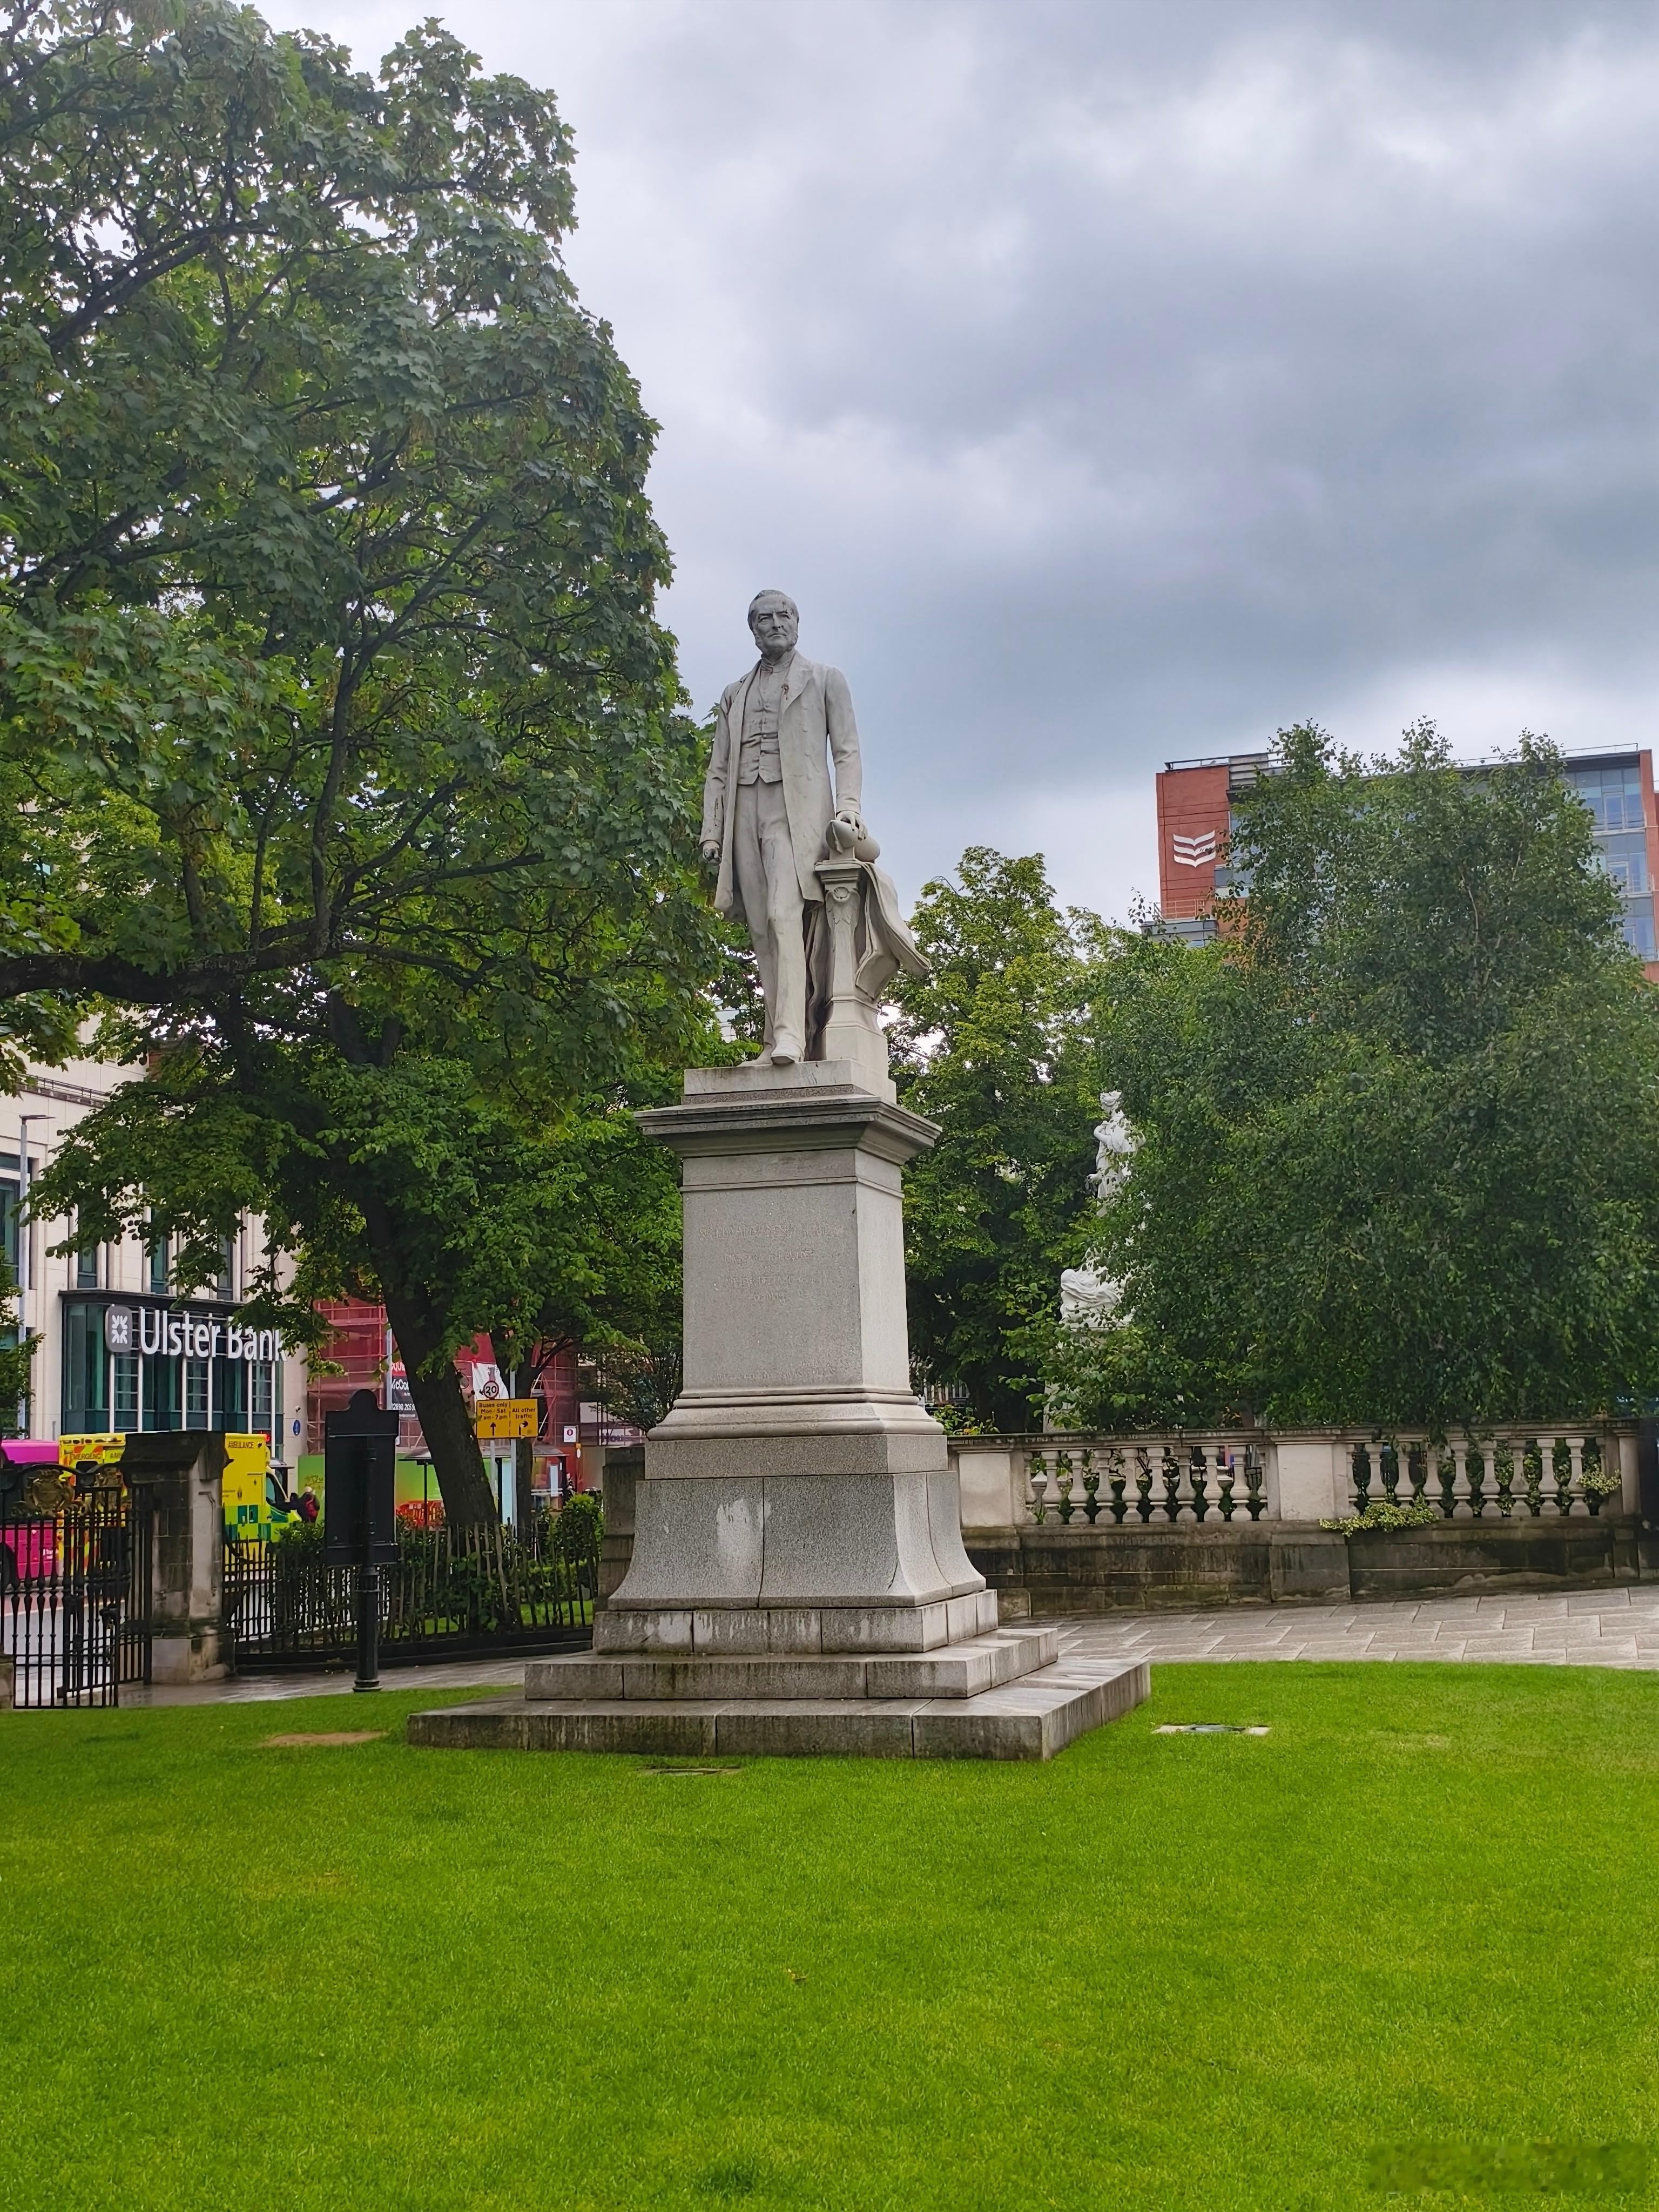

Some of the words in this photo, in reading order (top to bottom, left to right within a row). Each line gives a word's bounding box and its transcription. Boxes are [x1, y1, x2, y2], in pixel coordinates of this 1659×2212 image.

[140, 1307, 220, 1358] Ulster
[227, 1316, 288, 1361] Bank
[485, 1386, 497, 1394] 20
[228, 1441, 254, 1449] AMBULANCE
